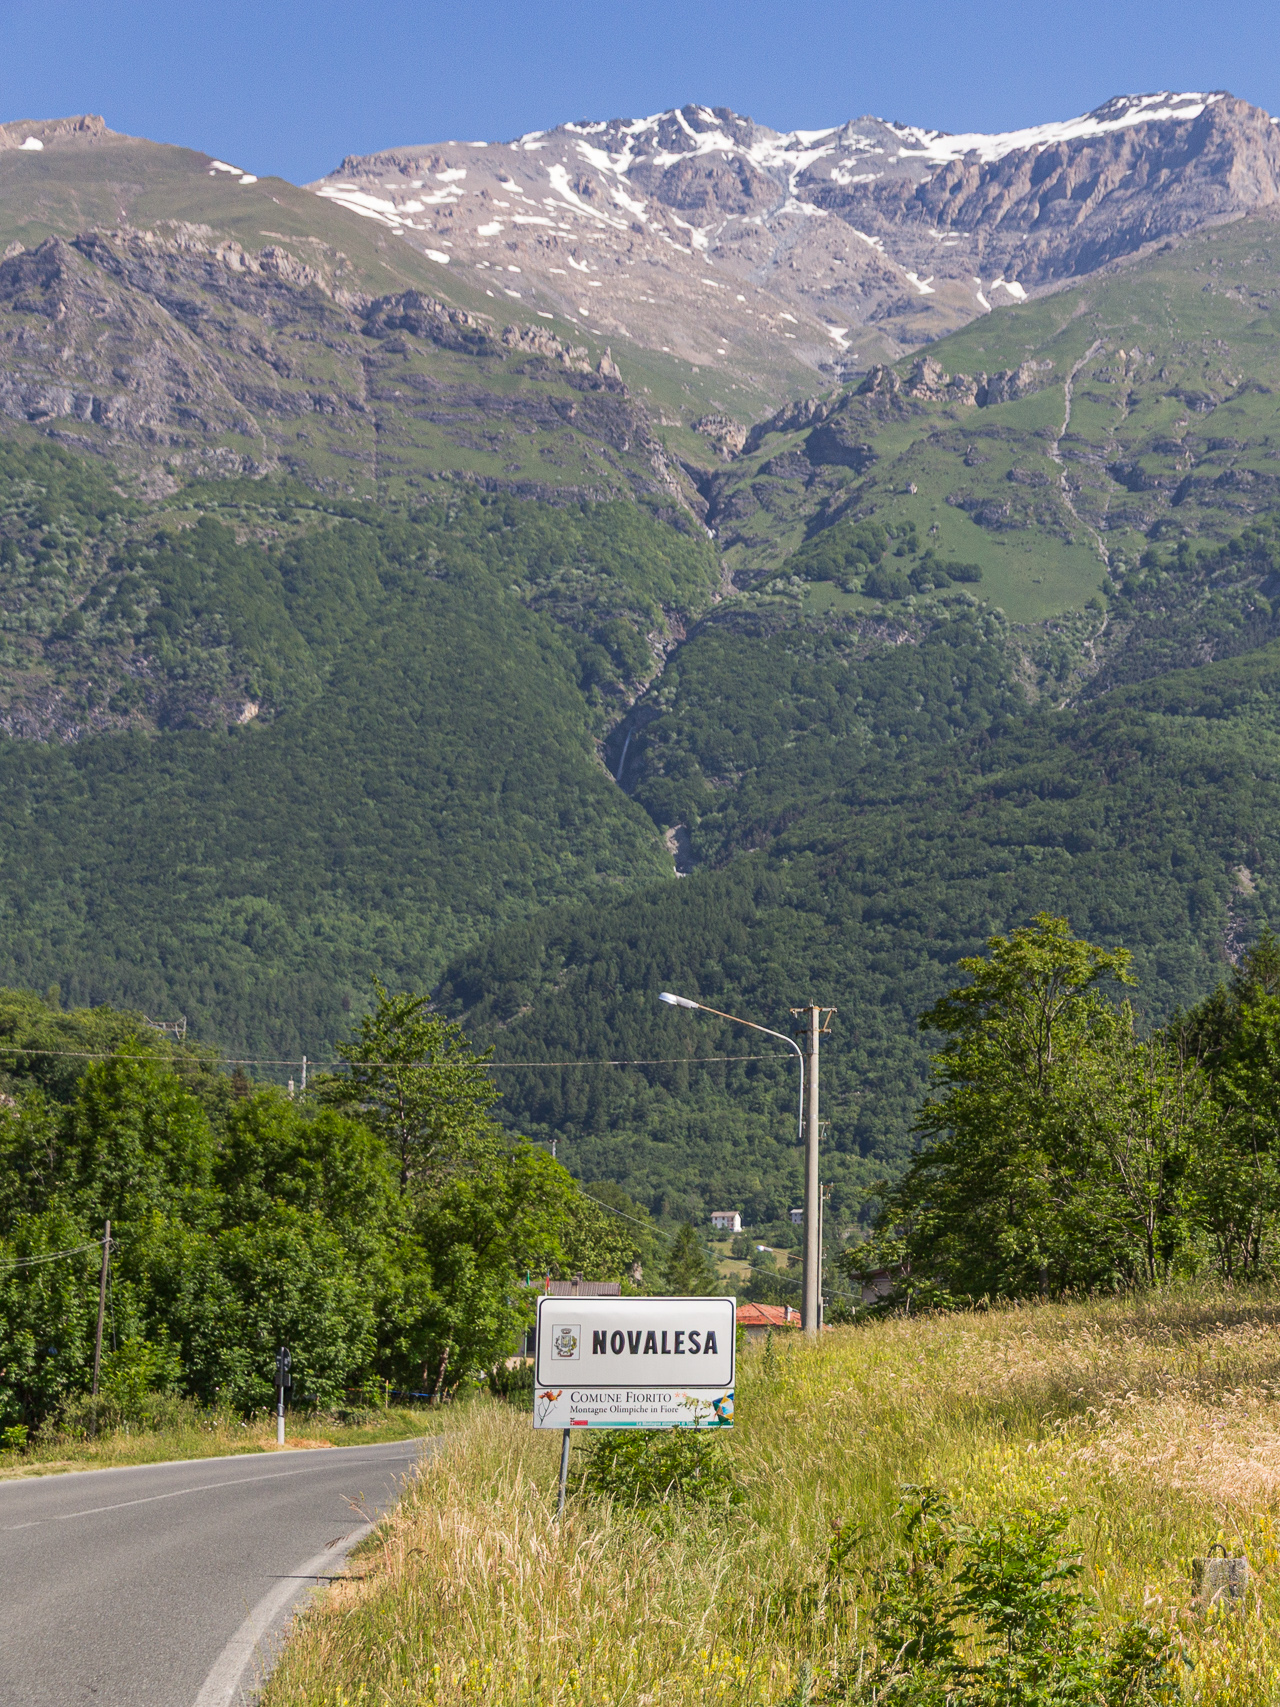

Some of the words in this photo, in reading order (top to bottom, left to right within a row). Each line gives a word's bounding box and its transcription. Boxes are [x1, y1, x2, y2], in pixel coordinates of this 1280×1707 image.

[592, 1330, 718, 1355] NOVALESA
[570, 1391, 622, 1403] COMUNE
[626, 1391, 672, 1403] FIORITO
[570, 1405, 607, 1415] Montagne
[609, 1404, 649, 1415] Olimpiche
[650, 1405, 658, 1413] in
[660, 1405, 679, 1413] Fiore
